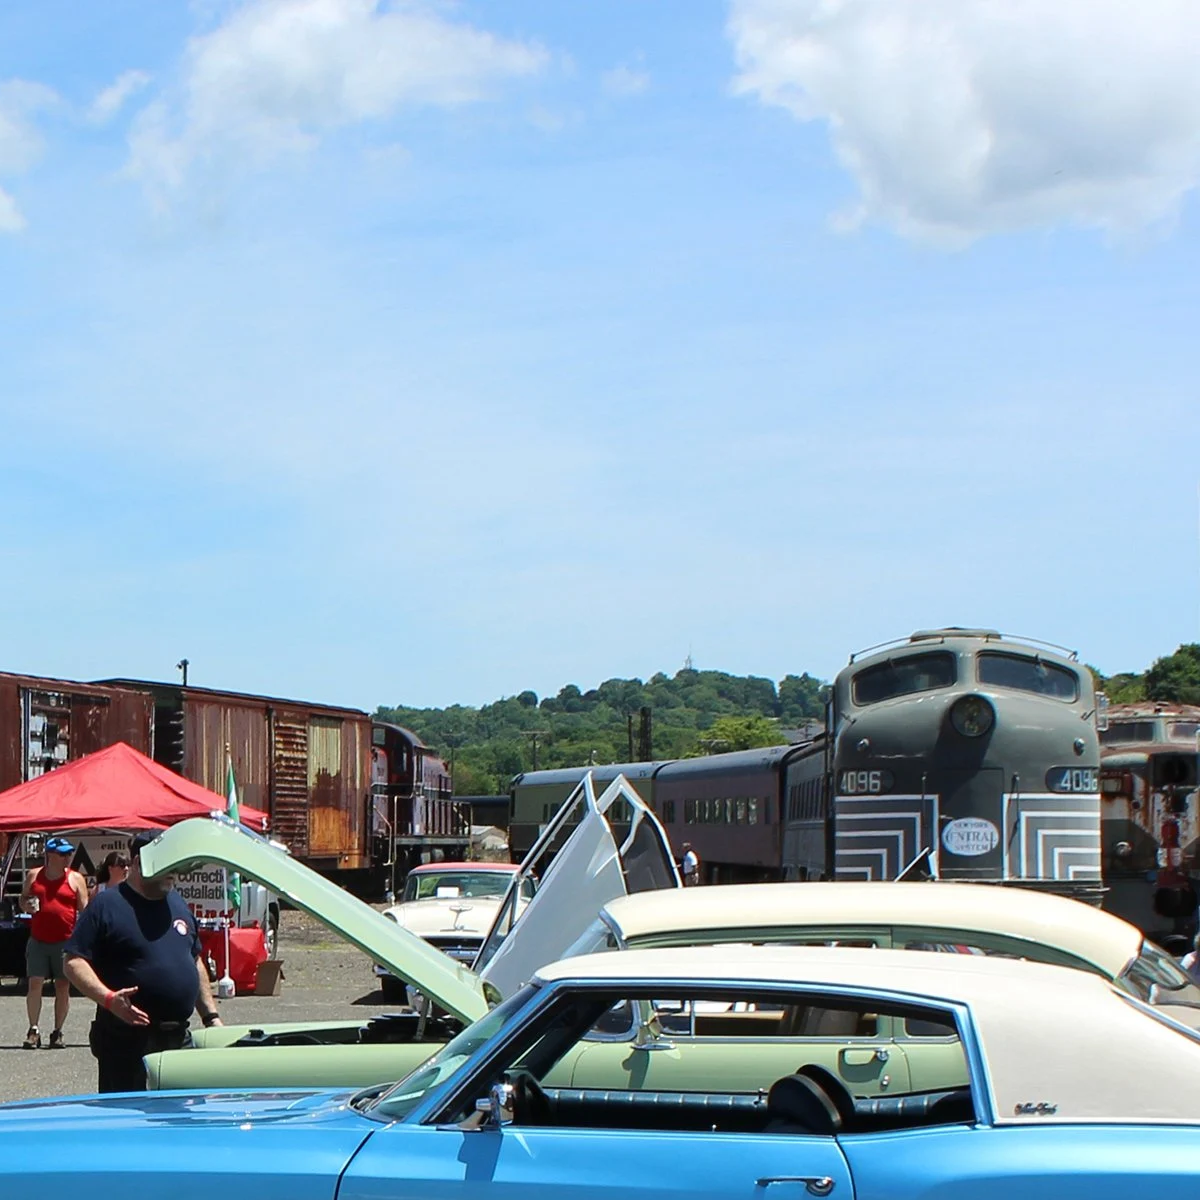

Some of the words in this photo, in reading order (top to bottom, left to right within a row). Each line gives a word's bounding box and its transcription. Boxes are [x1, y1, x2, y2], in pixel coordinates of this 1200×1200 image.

[840, 770, 881, 792] 4096
[178, 869, 226, 883] correcti
[174, 885, 230, 899] nstallati
